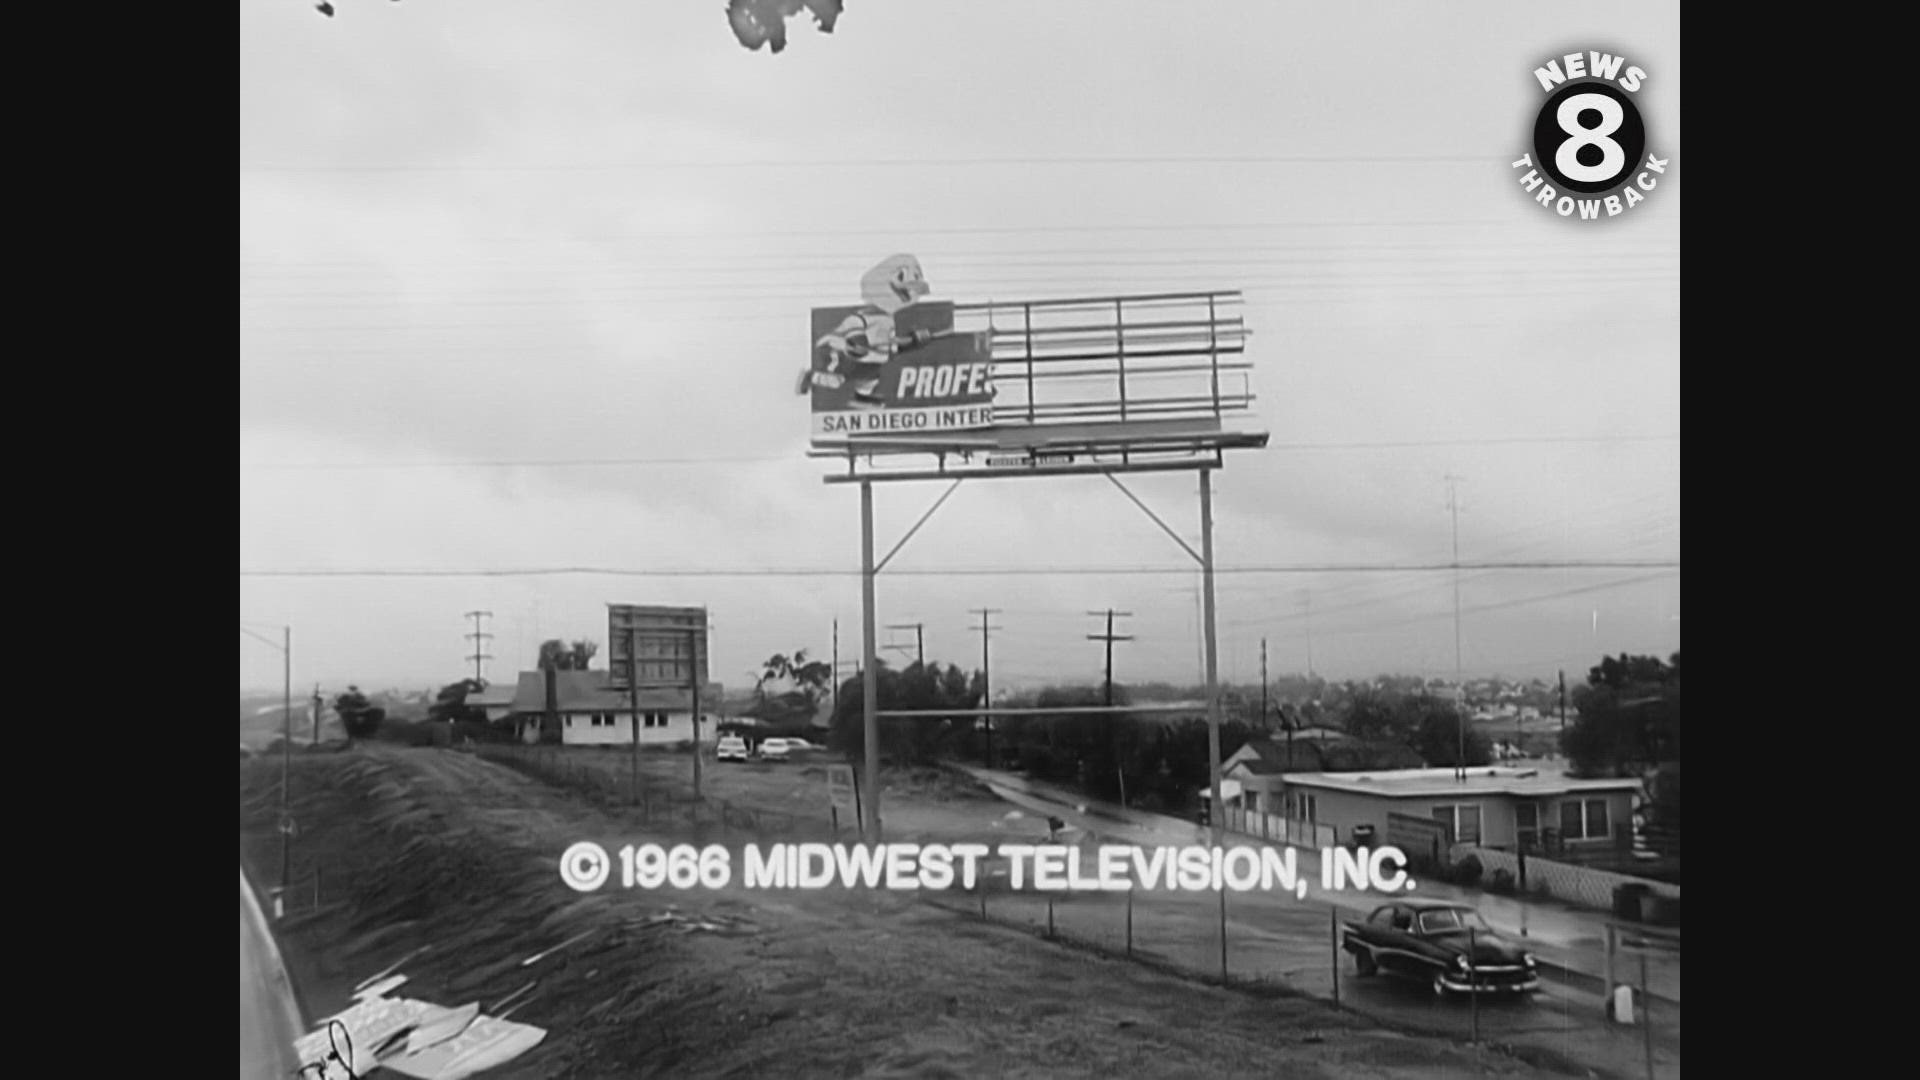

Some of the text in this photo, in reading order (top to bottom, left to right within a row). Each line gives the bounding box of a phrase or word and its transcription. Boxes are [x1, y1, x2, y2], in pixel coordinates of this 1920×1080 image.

[823, 408, 992, 432] SAN DIEGO INTER
